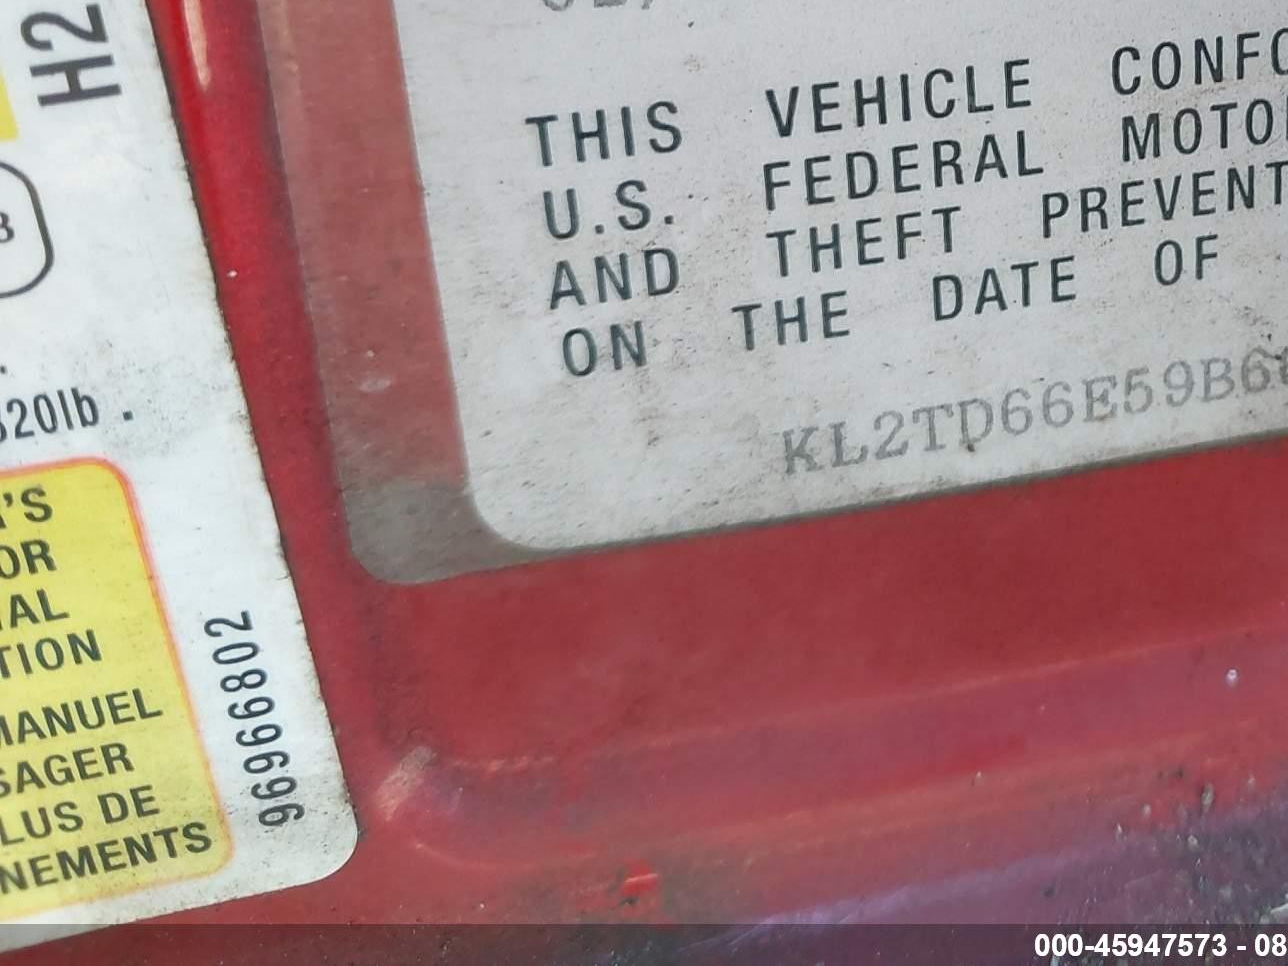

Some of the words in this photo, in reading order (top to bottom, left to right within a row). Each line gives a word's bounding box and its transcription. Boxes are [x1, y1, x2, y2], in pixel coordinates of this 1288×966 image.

[20, 4, 121, 106] H2
[525, 101, 683, 166] THIS
[765, 59, 1031, 138] VEHICLE
[543, 179, 674, 240] U.S.
[763, 130, 1044, 211] FEDERAL
[549, 248, 679, 309] AND
[766, 206, 961, 277] THEFT
[562, 321, 647, 376] ON
[732, 291, 850, 351] THE
[932, 256, 1076, 321] DATE
[1155, 235, 1219, 285] OF
[204, 609, 305, 827] 96966802
[97, 785, 160, 824] DE
